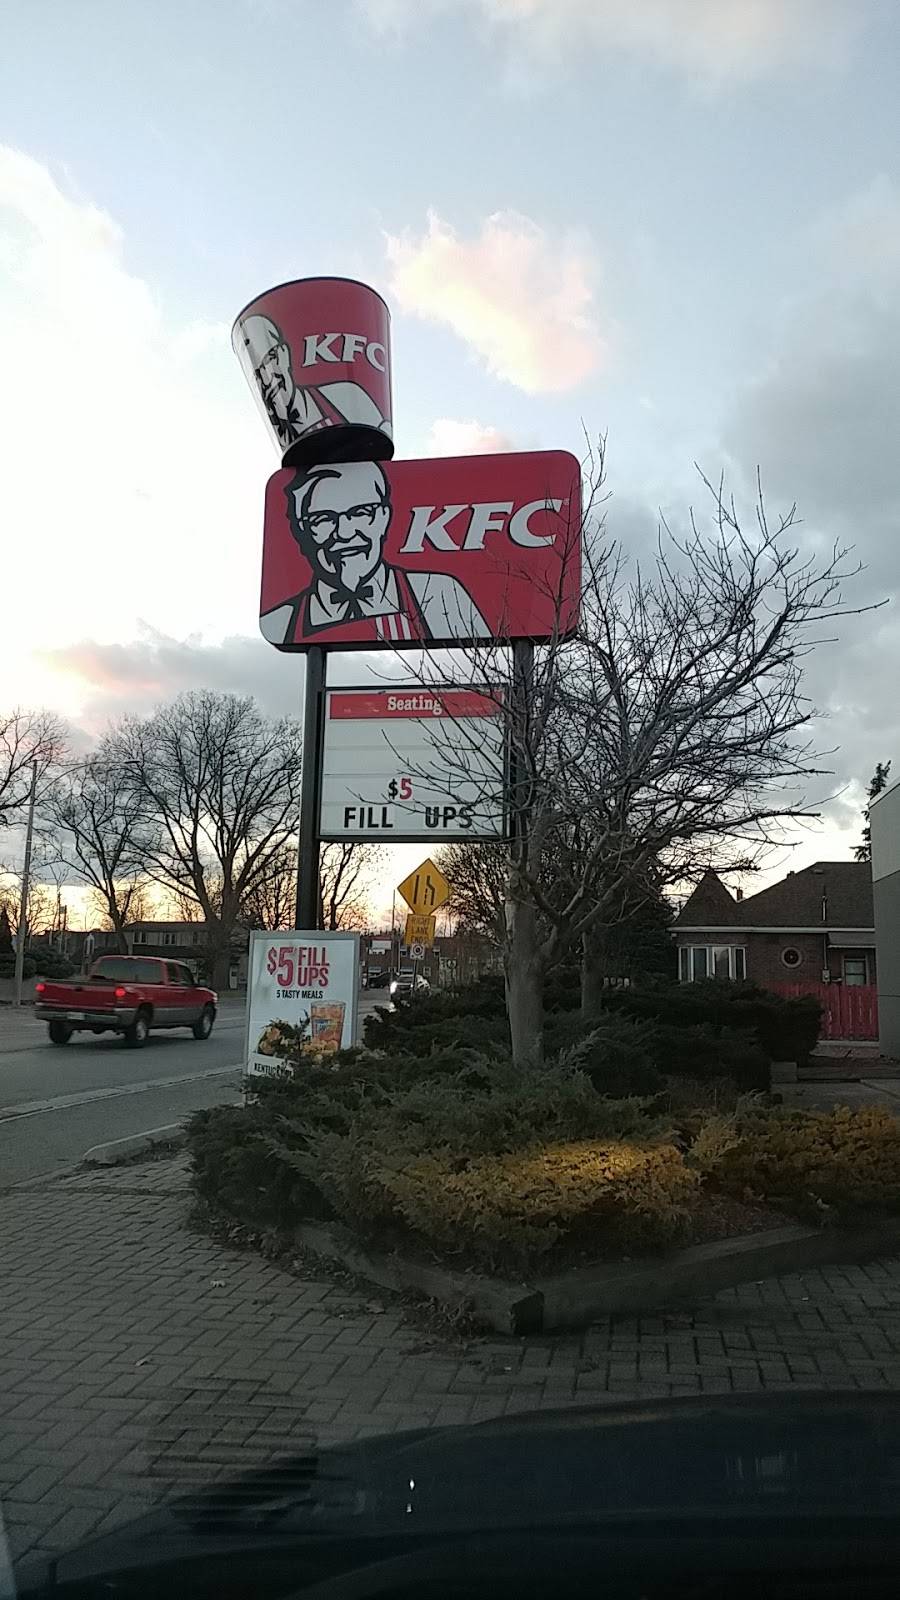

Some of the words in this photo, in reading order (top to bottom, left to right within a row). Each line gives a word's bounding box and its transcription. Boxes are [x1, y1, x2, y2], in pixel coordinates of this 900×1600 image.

[302, 333, 386, 372] KFC
[399, 499, 566, 553] KFC
[387, 695, 444, 716] Seating
[388, 778, 413, 800] $5
[343, 806, 394, 829] FILL
[424, 806, 473, 829] UPS
[267, 946, 294, 987] $5
[297, 946, 330, 967] FILL
[297, 967, 329, 987] UPS
[276, 989, 281, 999] 5
[282, 989, 301, 999] TASTY
[301, 990, 324, 999] MEALS
